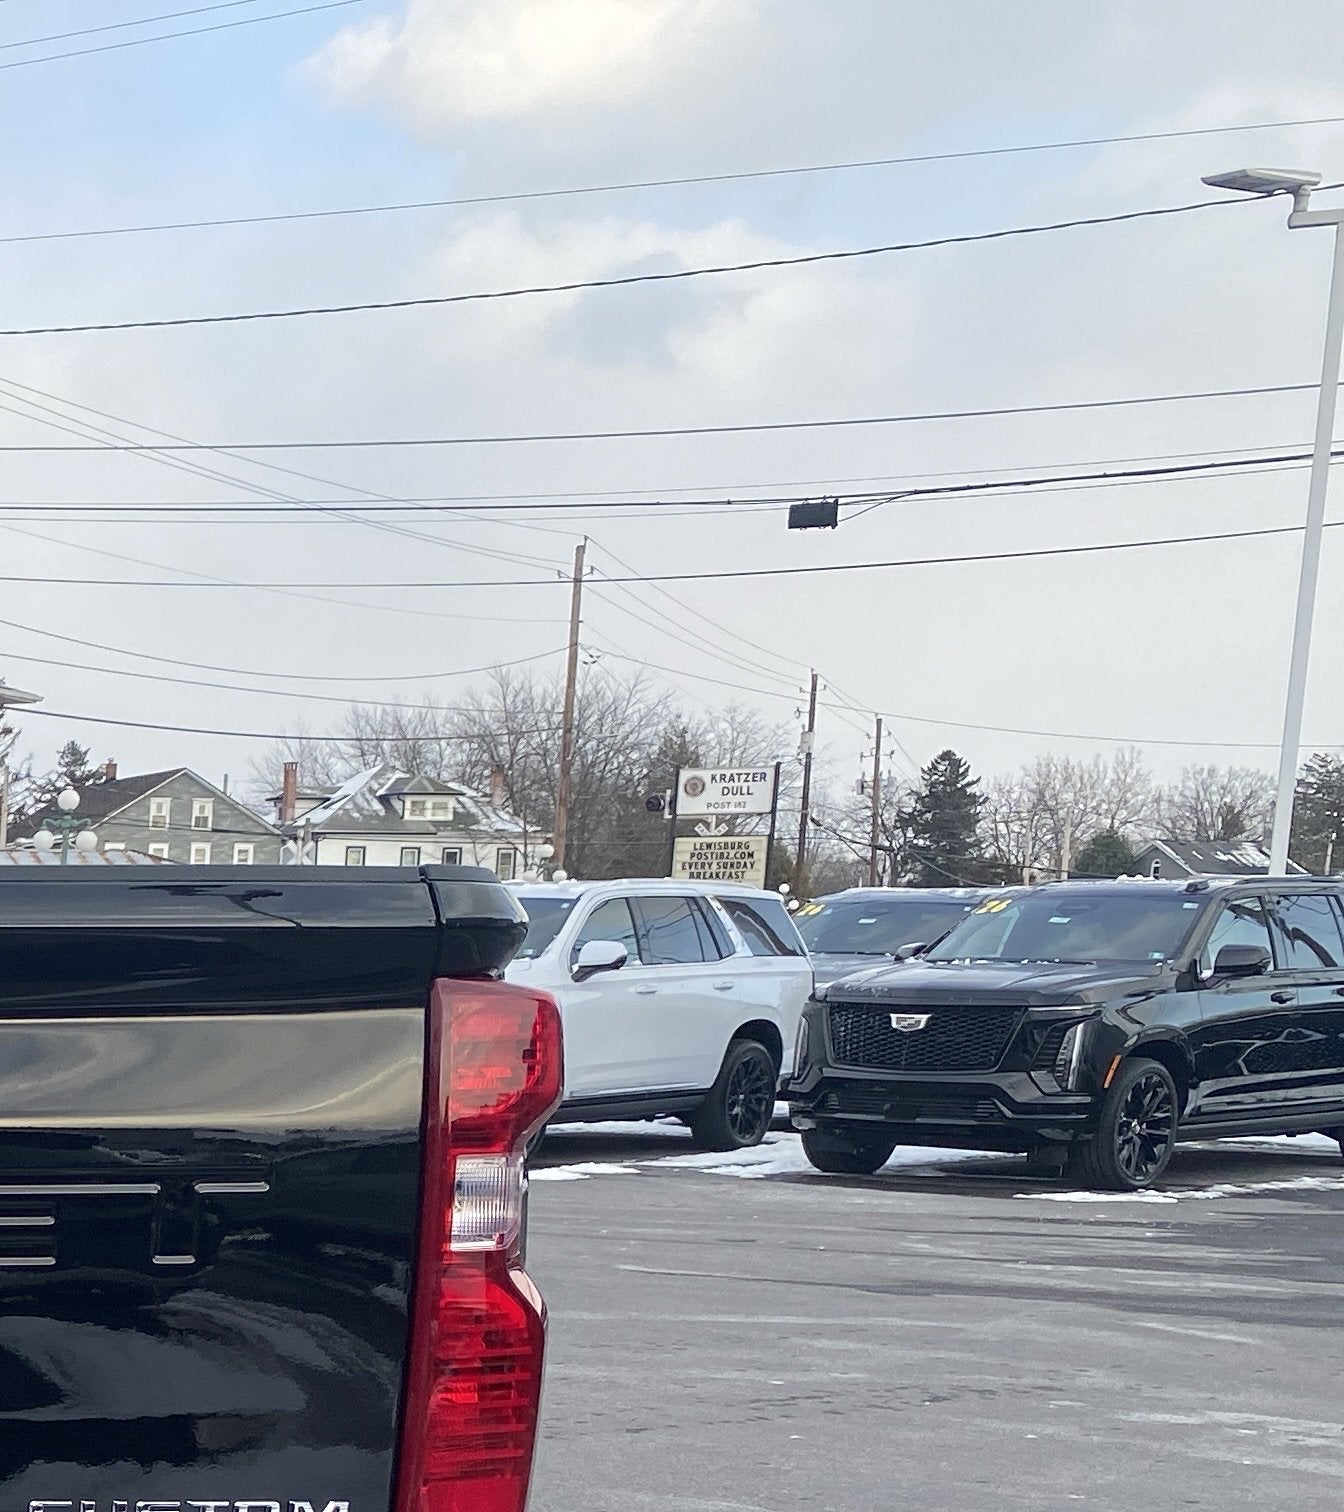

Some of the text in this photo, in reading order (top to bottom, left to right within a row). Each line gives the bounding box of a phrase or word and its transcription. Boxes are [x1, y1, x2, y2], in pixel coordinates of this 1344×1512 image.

[710, 772, 767, 784] KRATZER
[721, 785, 754, 796] DULL
[706, 802, 732, 810] POST
[693, 841, 750, 851] LEWISBURG
[681, 860, 755, 871] EVERY SUNDAY
[688, 870, 746, 880] BREAKFAST
